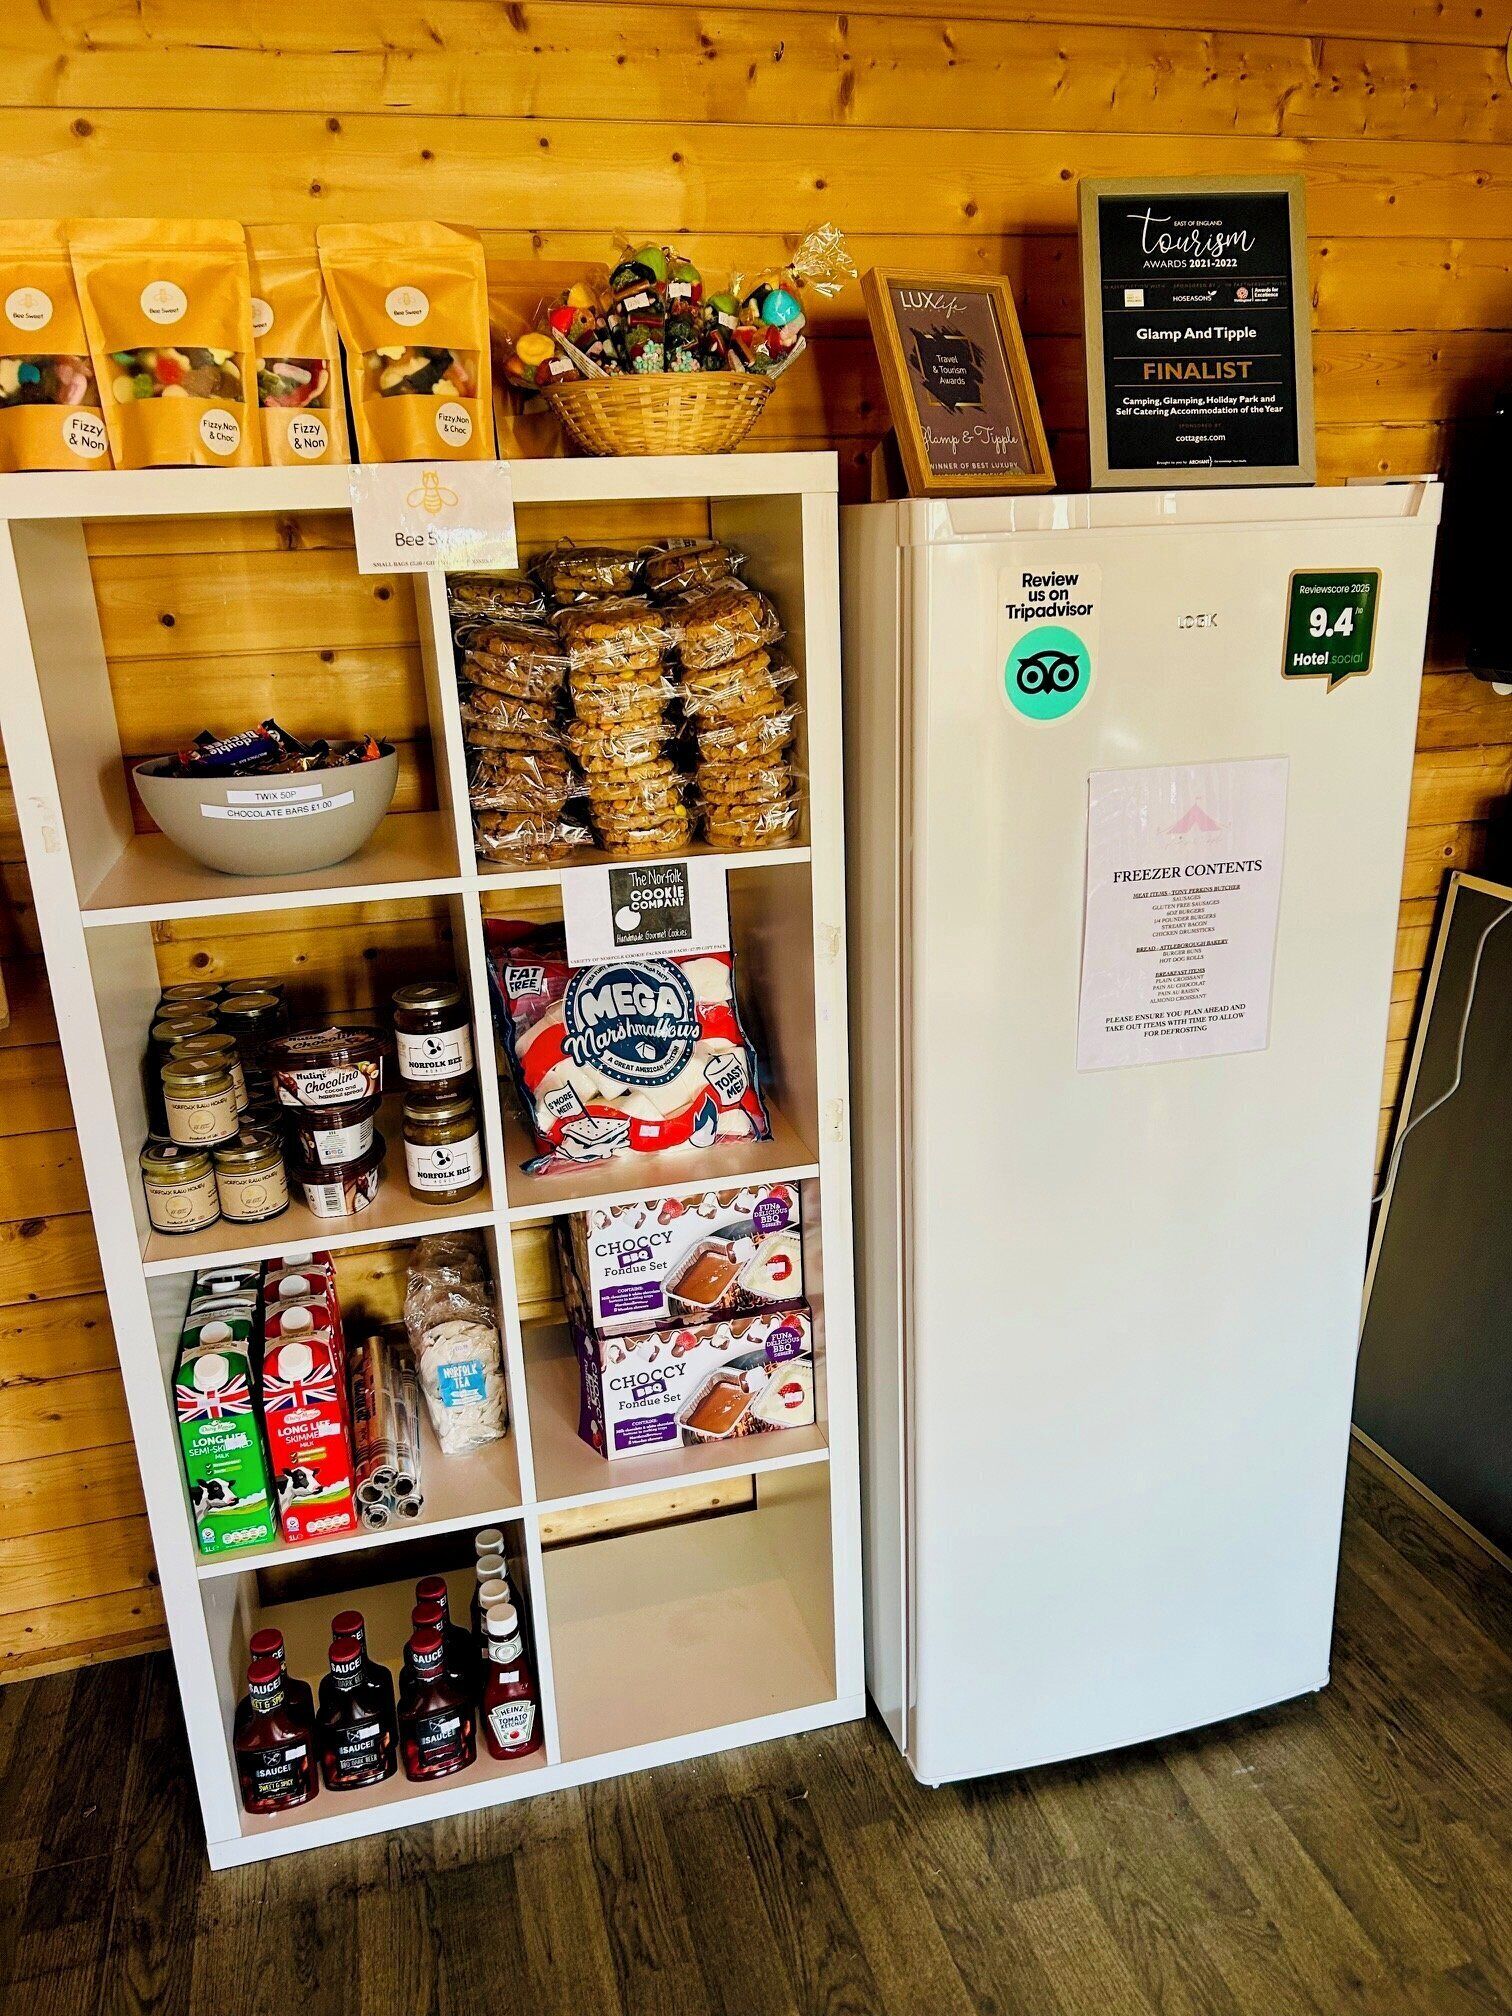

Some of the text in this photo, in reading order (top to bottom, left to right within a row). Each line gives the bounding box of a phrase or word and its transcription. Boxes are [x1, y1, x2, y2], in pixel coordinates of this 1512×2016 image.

[1126, 207, 1256, 258] tourism
[1143, 258, 1238, 268] AWARDS 2021-2022
[1136, 326, 1256, 342] Glamp And Tipple
[936, 354, 958, 364] Travel
[932, 365, 967, 374] & Tourism
[1144, 361, 1252, 380] FINALIST
[940, 376, 966, 384] Awards
[1123, 394, 1276, 406] Camping, Glamping, Holiday Park and
[1116, 407, 1132, 416] Self
[1134, 407, 1169, 416] Catering
[1170, 406, 1238, 415] Accommodation
[1250, 406, 1264, 414] the
[1264, 405, 1283, 413] Year
[72, 419, 104, 436] Fizzy
[293, 422, 320, 436] Fizzy
[444, 424, 466, 434] & Choc
[69, 433, 105, 451] & Non
[209, 432, 234, 443] & Choc
[294, 437, 325, 450] & Non
[963, 425, 1018, 454] & Tipple
[1176, 434, 1226, 443] cottages.com
[395, 532, 424, 547] Bee
[1022, 571, 1079, 588] Review
[1028, 588, 1069, 602] us on
[1300, 584, 1370, 594] Reviewscore 2025
[1006, 602, 1093, 622] Tripadvisor
[1310, 606, 1354, 638] 9.4
[1294, 652, 1329, 666] Hotel
[203, 730, 259, 750] DECKER
[210, 738, 250, 755] double
[280, 790, 296, 800] 50P
[227, 805, 310, 818] CHOCOLATE BARS
[629, 867, 684, 887] The Norfolk
[1113, 859, 1262, 883] FREEZER CONTENTS
[630, 885, 684, 902] COOKIE
[630, 898, 684, 911] COMPANY
[1179, 908, 1205, 916] BURGERS
[1162, 916, 1190, 924] POUNDER
[616, 928, 688, 944] Handmade Gourmet Cookies
[1179, 926, 1216, 935] DRUMSTICKS
[509, 968, 540, 982] FAT
[509, 980, 538, 994] FREE
[581, 982, 684, 1026] MEGA
[1106, 1015, 1134, 1024] PLEASE
[1135, 1012, 1164, 1022] ENSURE
[1184, 1008, 1202, 1016] PLAN
[1204, 1006, 1229, 1014] AHEAD
[1106, 1024, 1124, 1032] TAKE
[1144, 1020, 1166, 1029] ITEMS
[1168, 1018, 1187, 1026] WITH
[1220, 1012, 1245, 1020] ALLOW
[1144, 1025, 1208, 1038] FOR DEFROSTING
[564, 1017, 700, 1064] Marshmallows
[409, 1056, 463, 1068] NORFOLK BEE
[614, 1060, 634, 1071] GREAT
[635, 1065, 664, 1073] AMERICAN
[306, 1070, 358, 1094] Chocolino
[714, 1065, 743, 1090] TOAST
[344, 1088, 364, 1096] spread
[548, 1090, 574, 1110] S'MORE
[456, 1166, 472, 1176] BEE
[754, 1208, 788, 1218] DELICIOUS
[761, 1214, 780, 1224] BBQ
[595, 1231, 672, 1256] CHOCCY
[622, 1250, 650, 1265] BBQ
[604, 1262, 668, 1276] Fondue Set
[766, 1336, 800, 1347] DELICIOUS
[773, 1344, 792, 1352] BBQ
[443, 1364, 478, 1378] NORFOLK
[610, 1363, 687, 1390] CHOCCY
[454, 1377, 470, 1388] TEA
[637, 1382, 664, 1398] BBQ
[618, 1394, 682, 1410] Fondue Set
[278, 1424, 308, 1438] LONG
[192, 1435, 224, 1448] LONG
[499, 1712, 528, 1724] TOMATO
[500, 1706, 524, 1716] HEINZ
[501, 1720, 527, 1729] KETCHUP
